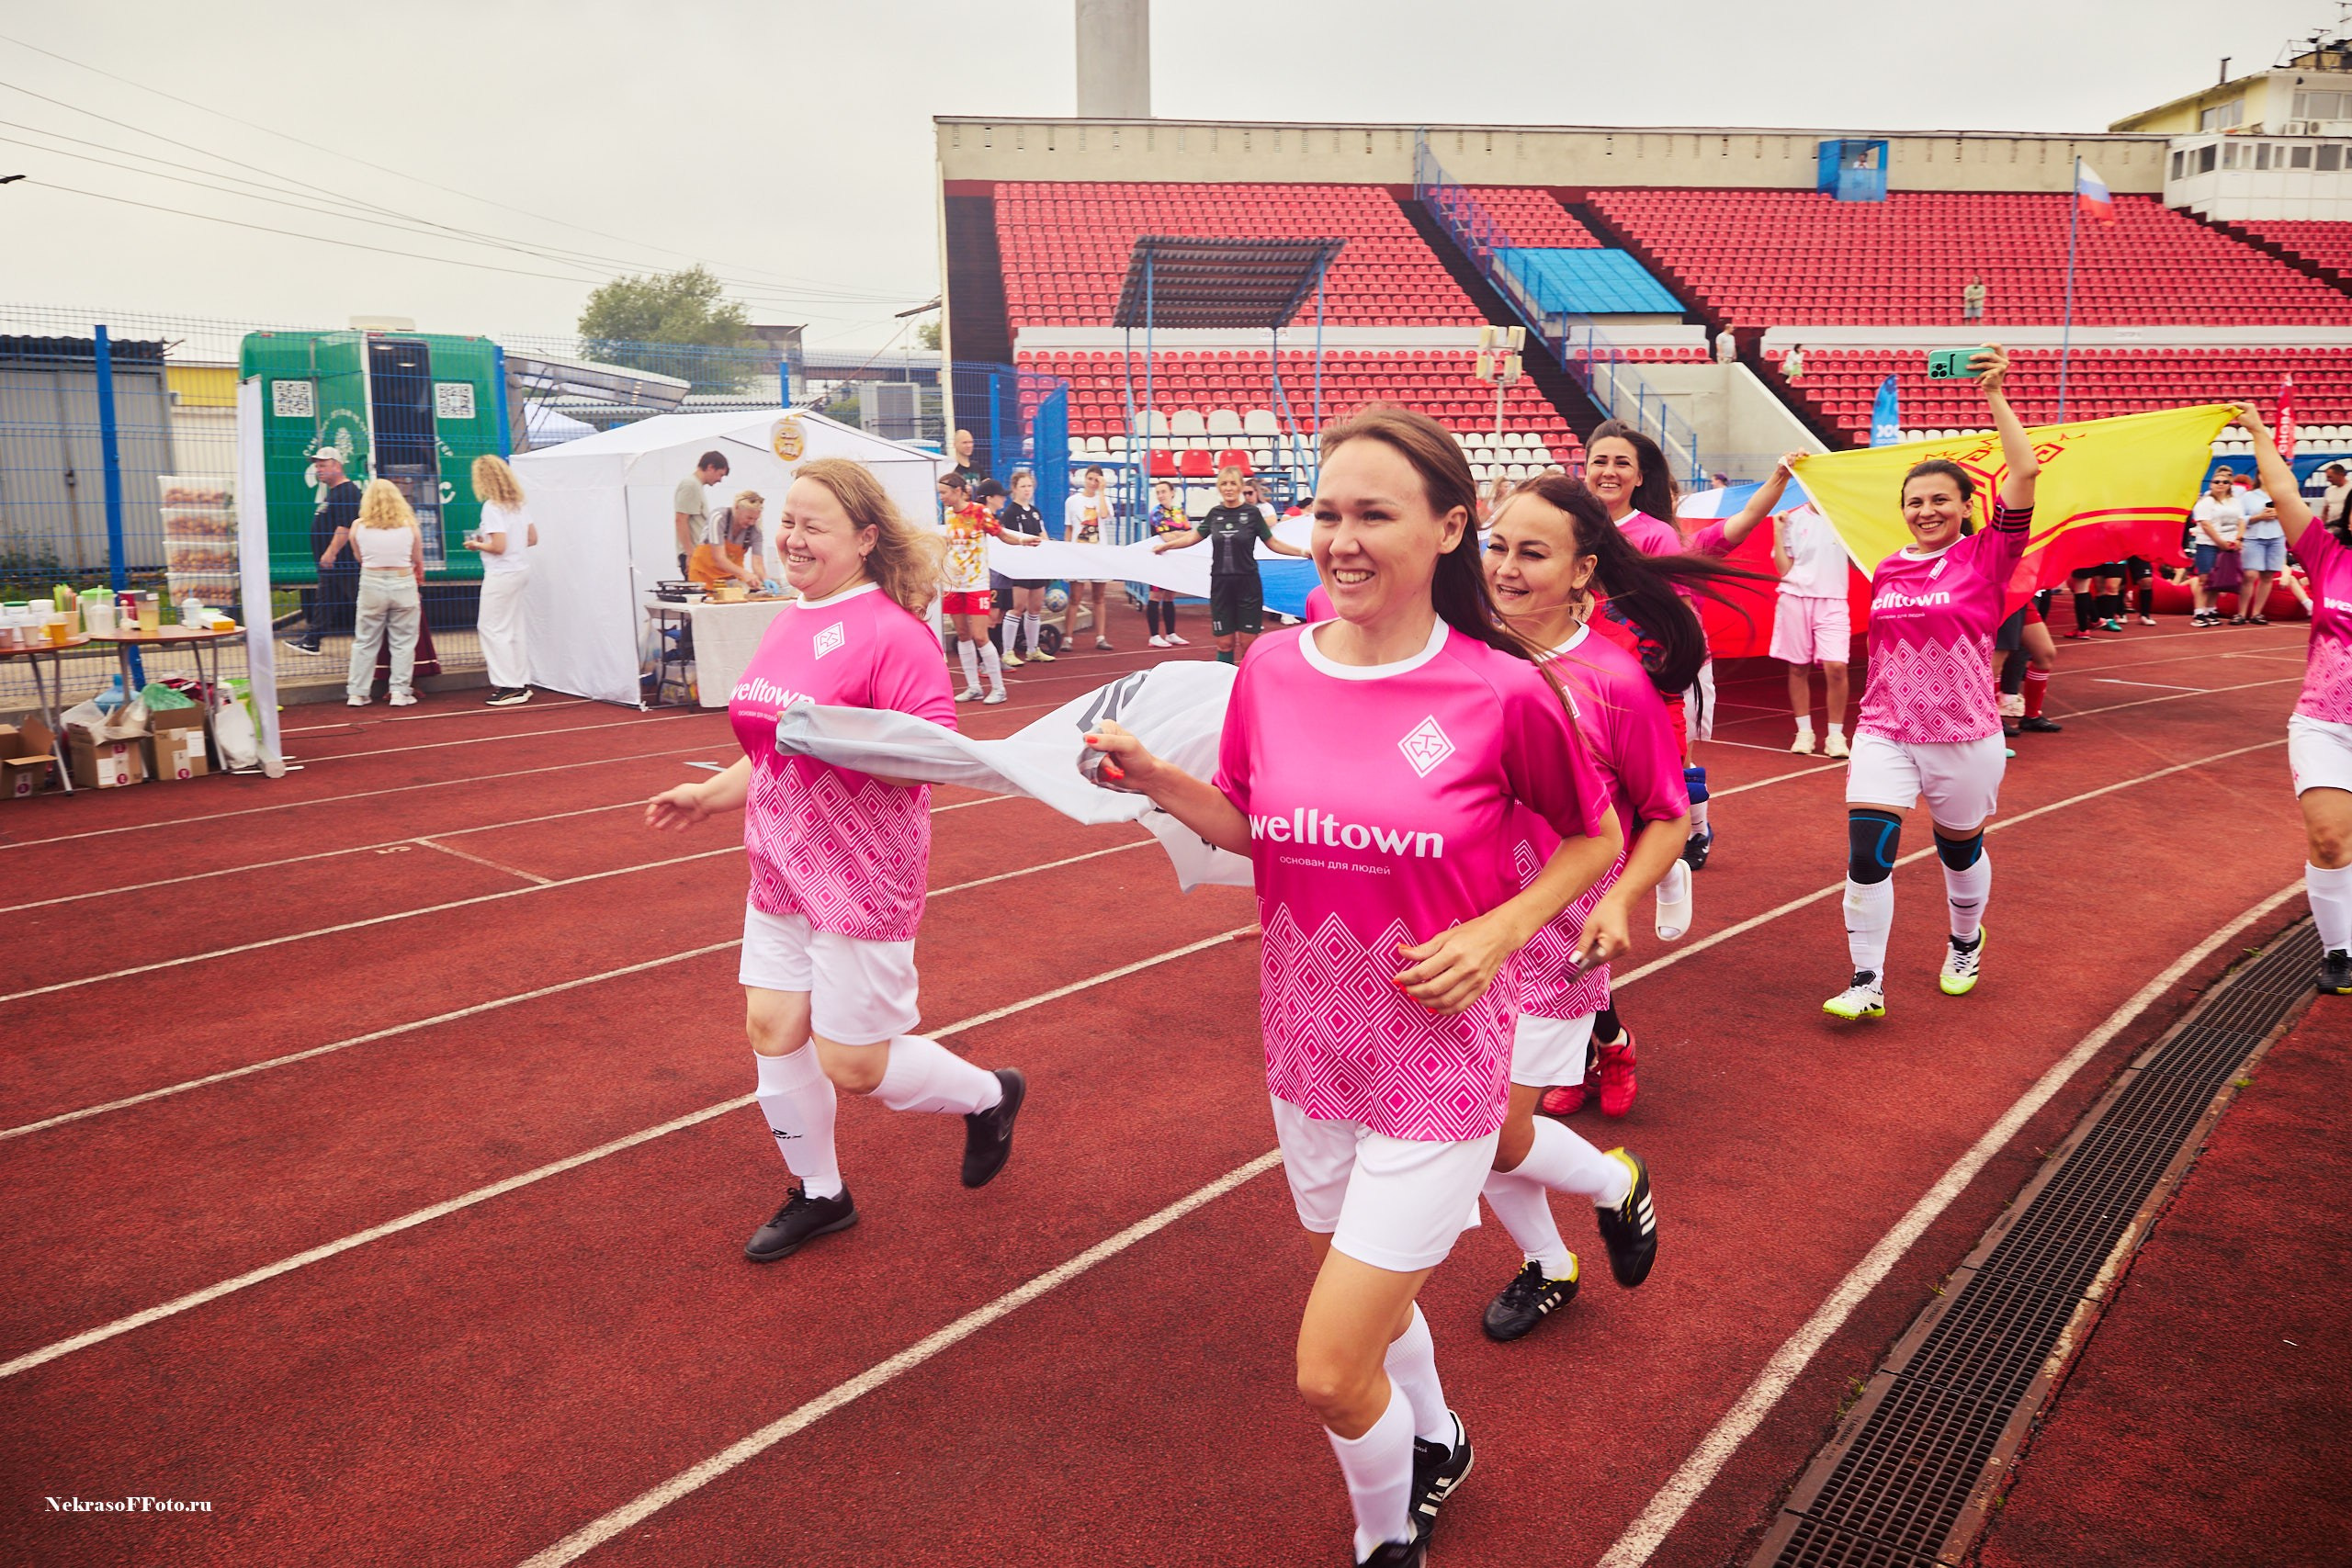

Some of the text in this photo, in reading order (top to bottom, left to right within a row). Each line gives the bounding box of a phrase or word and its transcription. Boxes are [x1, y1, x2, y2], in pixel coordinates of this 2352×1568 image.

[978, 596, 990, 610] 15
[1871, 592, 1950, 610] elltown
[1249, 807, 1444, 858] welltown
[1279, 855, 1391, 875] основан для людей
